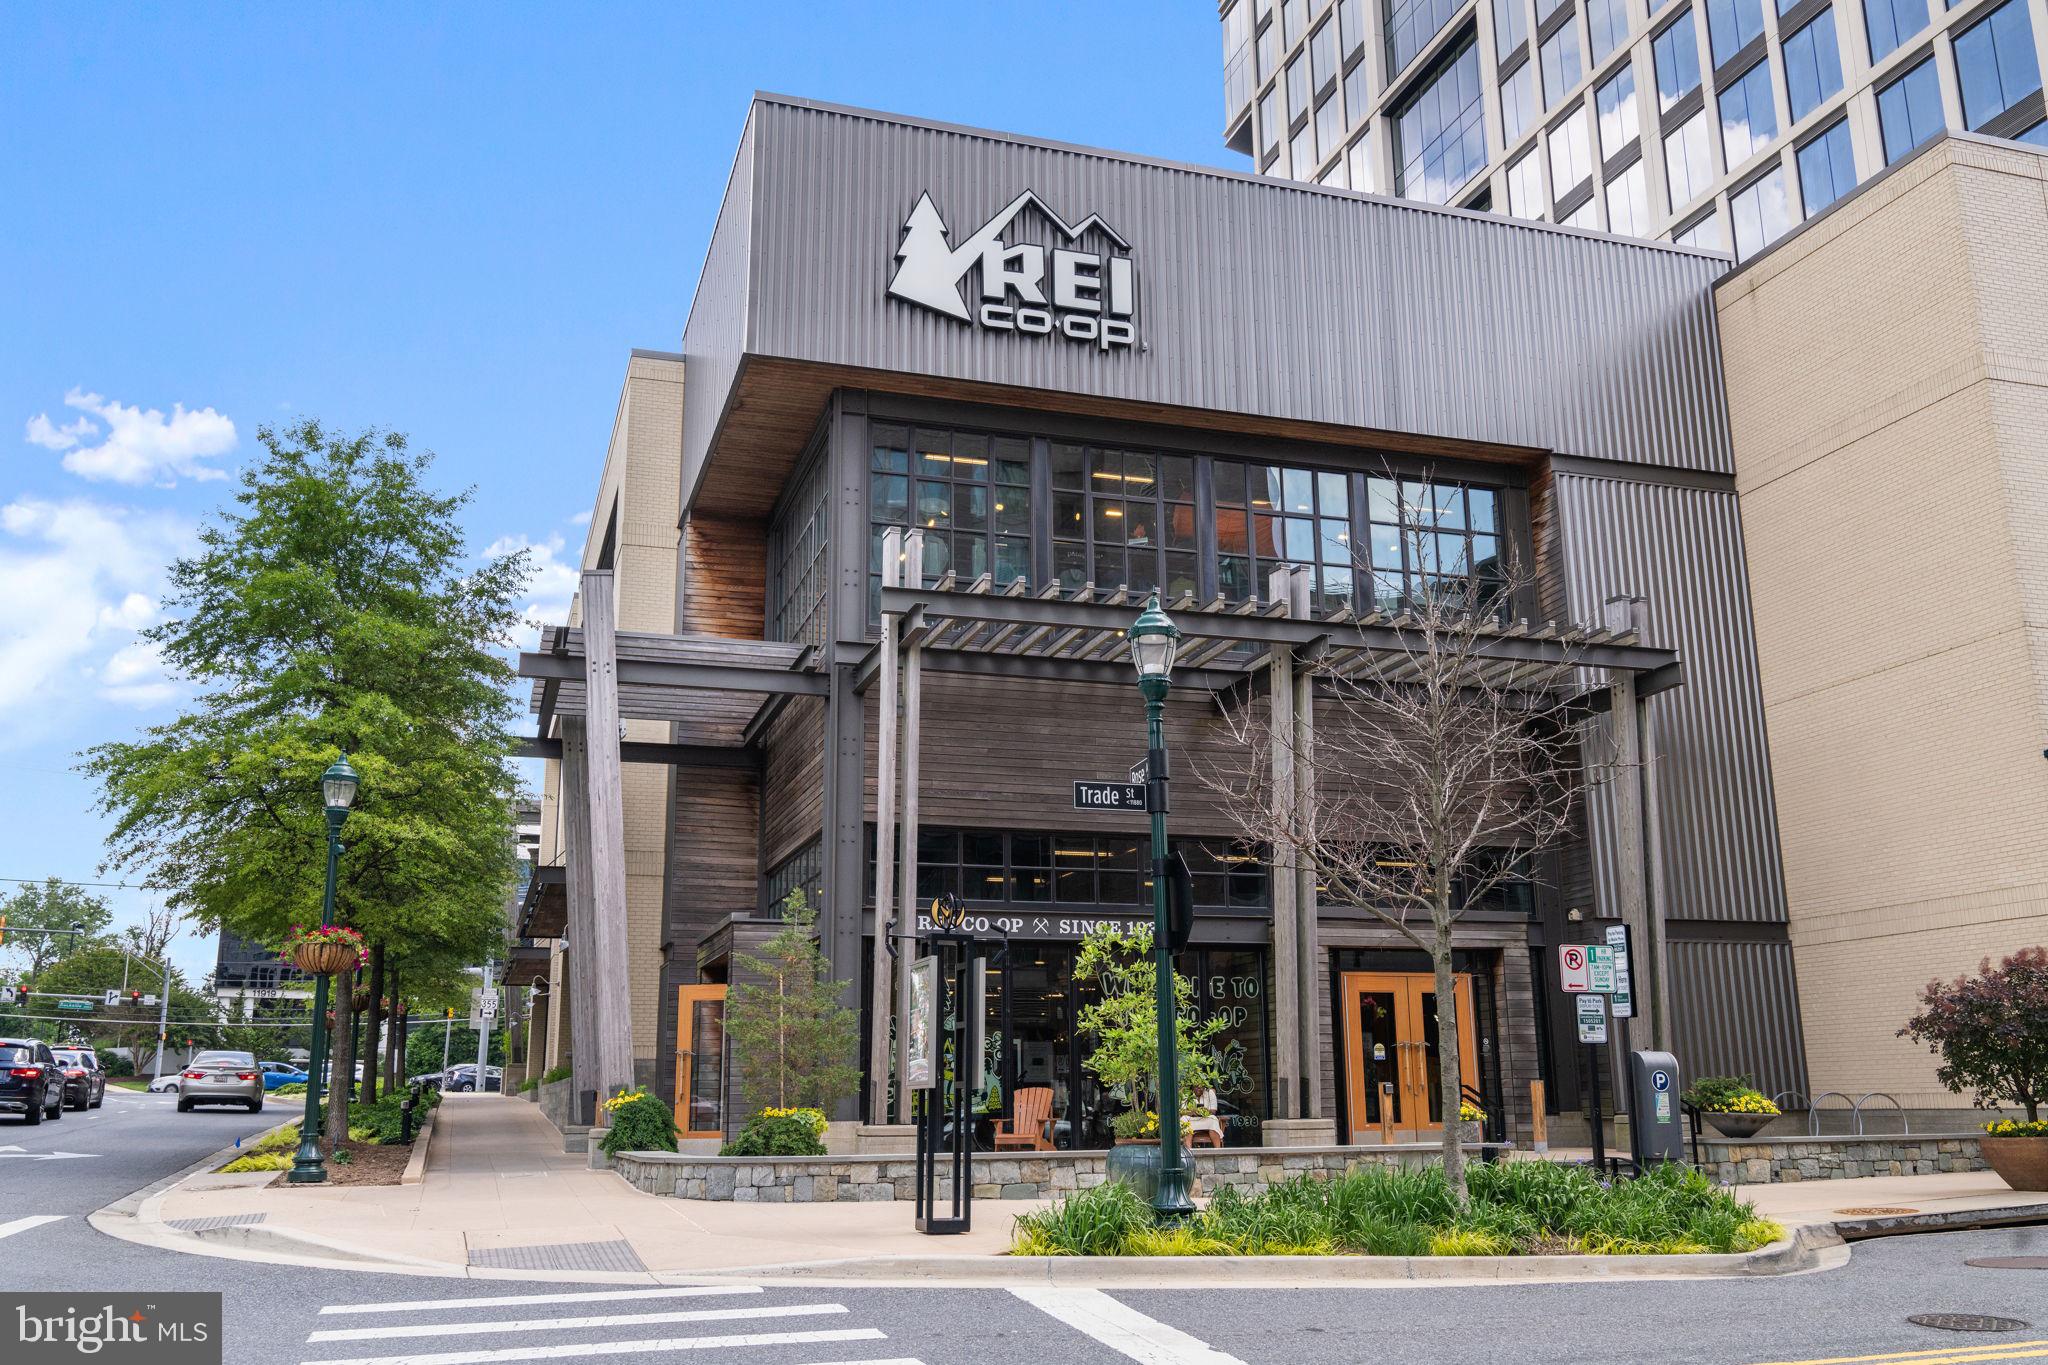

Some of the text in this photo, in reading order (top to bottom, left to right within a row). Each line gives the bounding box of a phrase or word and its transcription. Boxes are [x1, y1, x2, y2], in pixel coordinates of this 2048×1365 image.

[981, 242, 1134, 318] REI
[1080, 786, 1135, 805] Trade St
[962, 916, 1024, 933] COOP
[1060, 919, 1121, 936] SINCE
[252, 989, 277, 998] 11919
[1231, 976, 1259, 999] TO
[481, 1000, 497, 1009] 355
[1232, 1115, 1259, 1129] 1938
